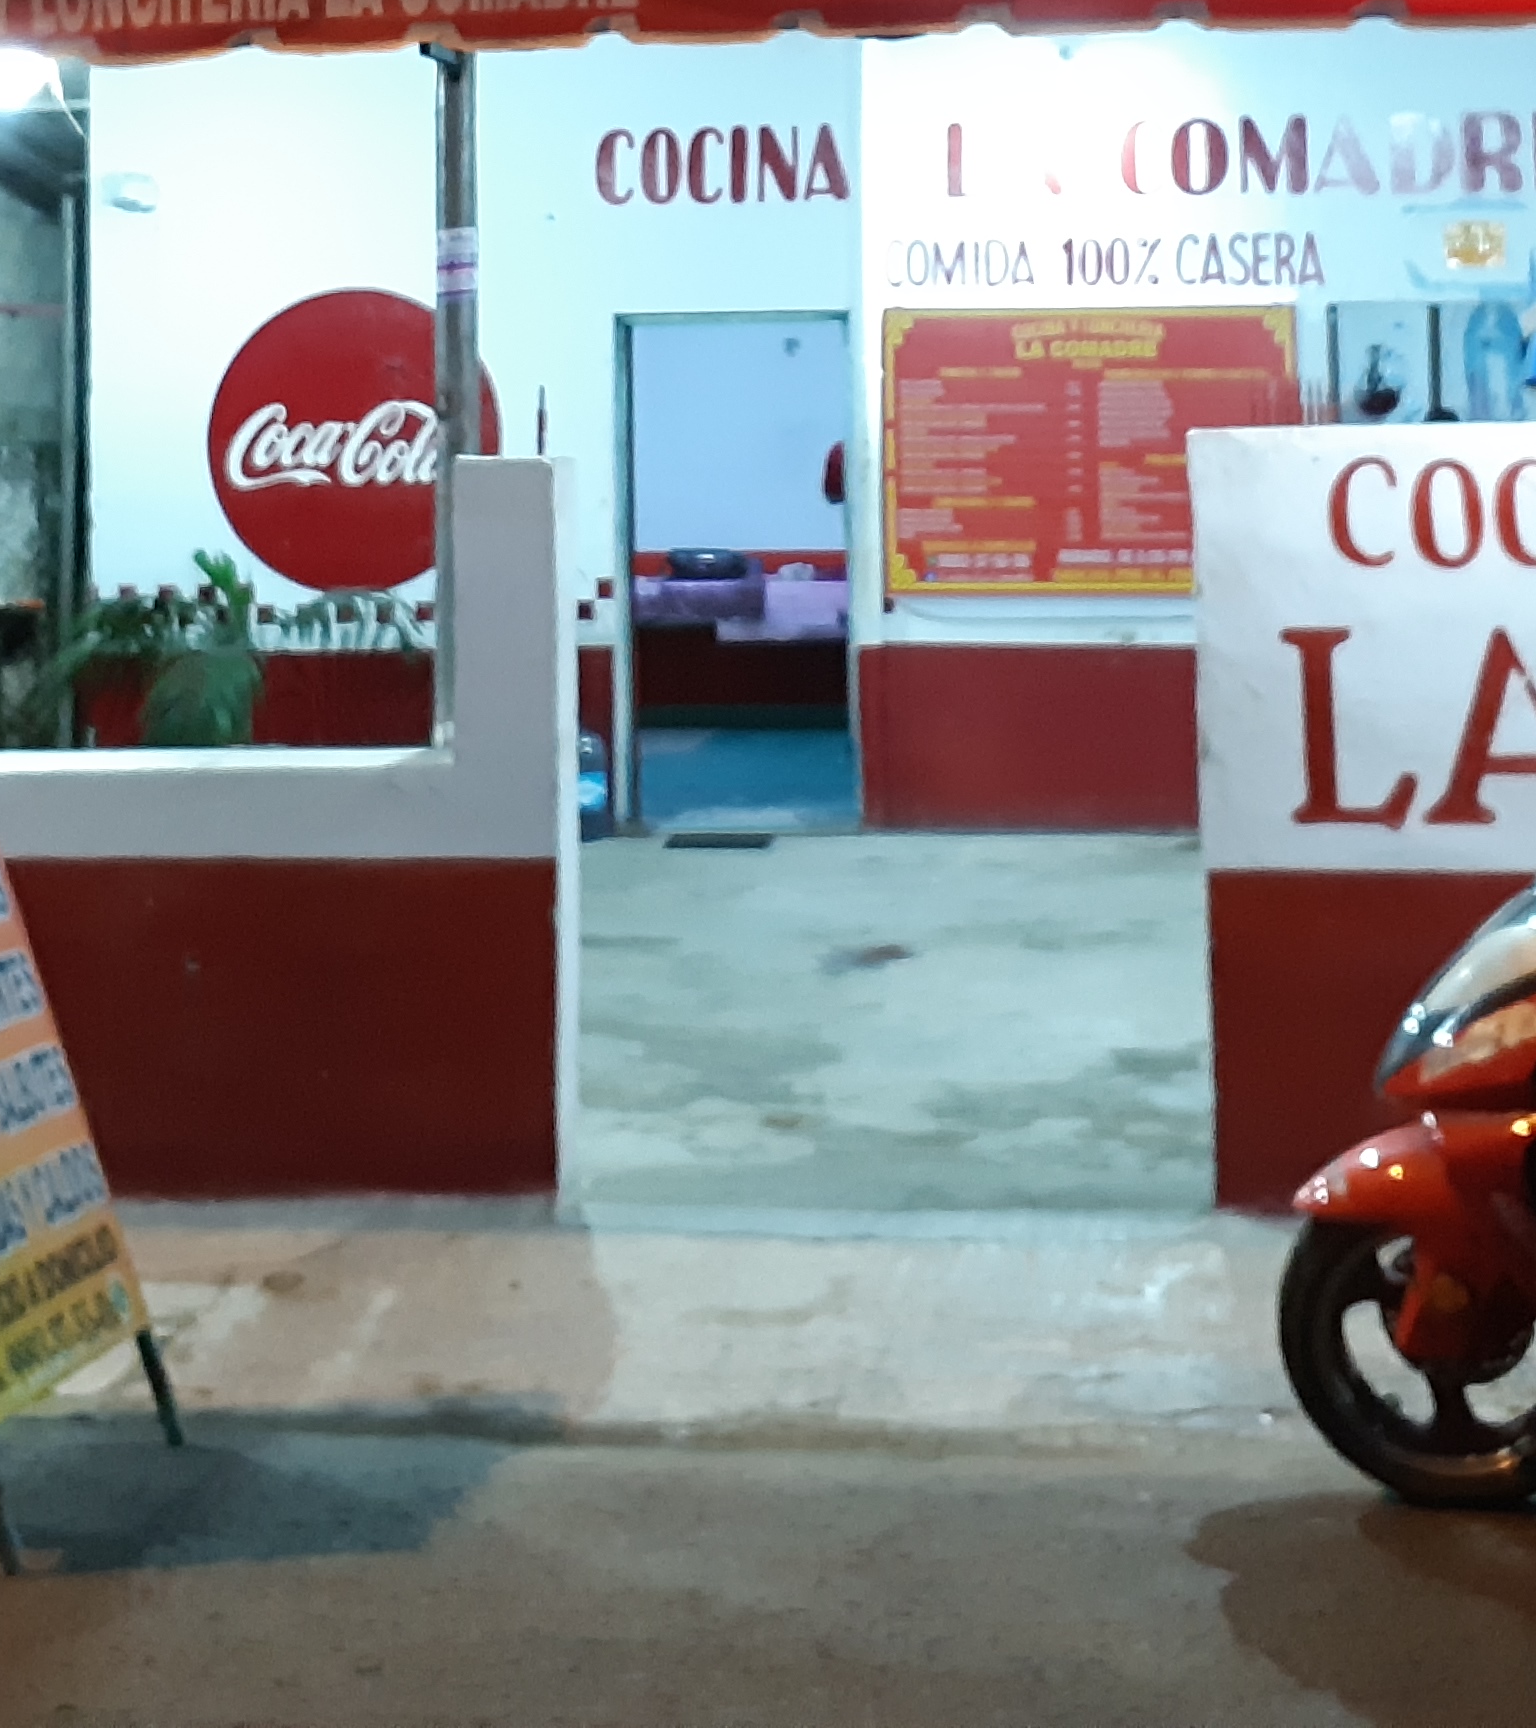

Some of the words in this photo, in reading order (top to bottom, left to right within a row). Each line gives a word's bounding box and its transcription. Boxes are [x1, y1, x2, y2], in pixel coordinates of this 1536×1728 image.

[595, 122, 850, 204] COCINA
[885, 238, 1035, 288] COMIDA
[1062, 237, 1162, 287] 100%
[1175, 231, 1326, 287] CASERA
